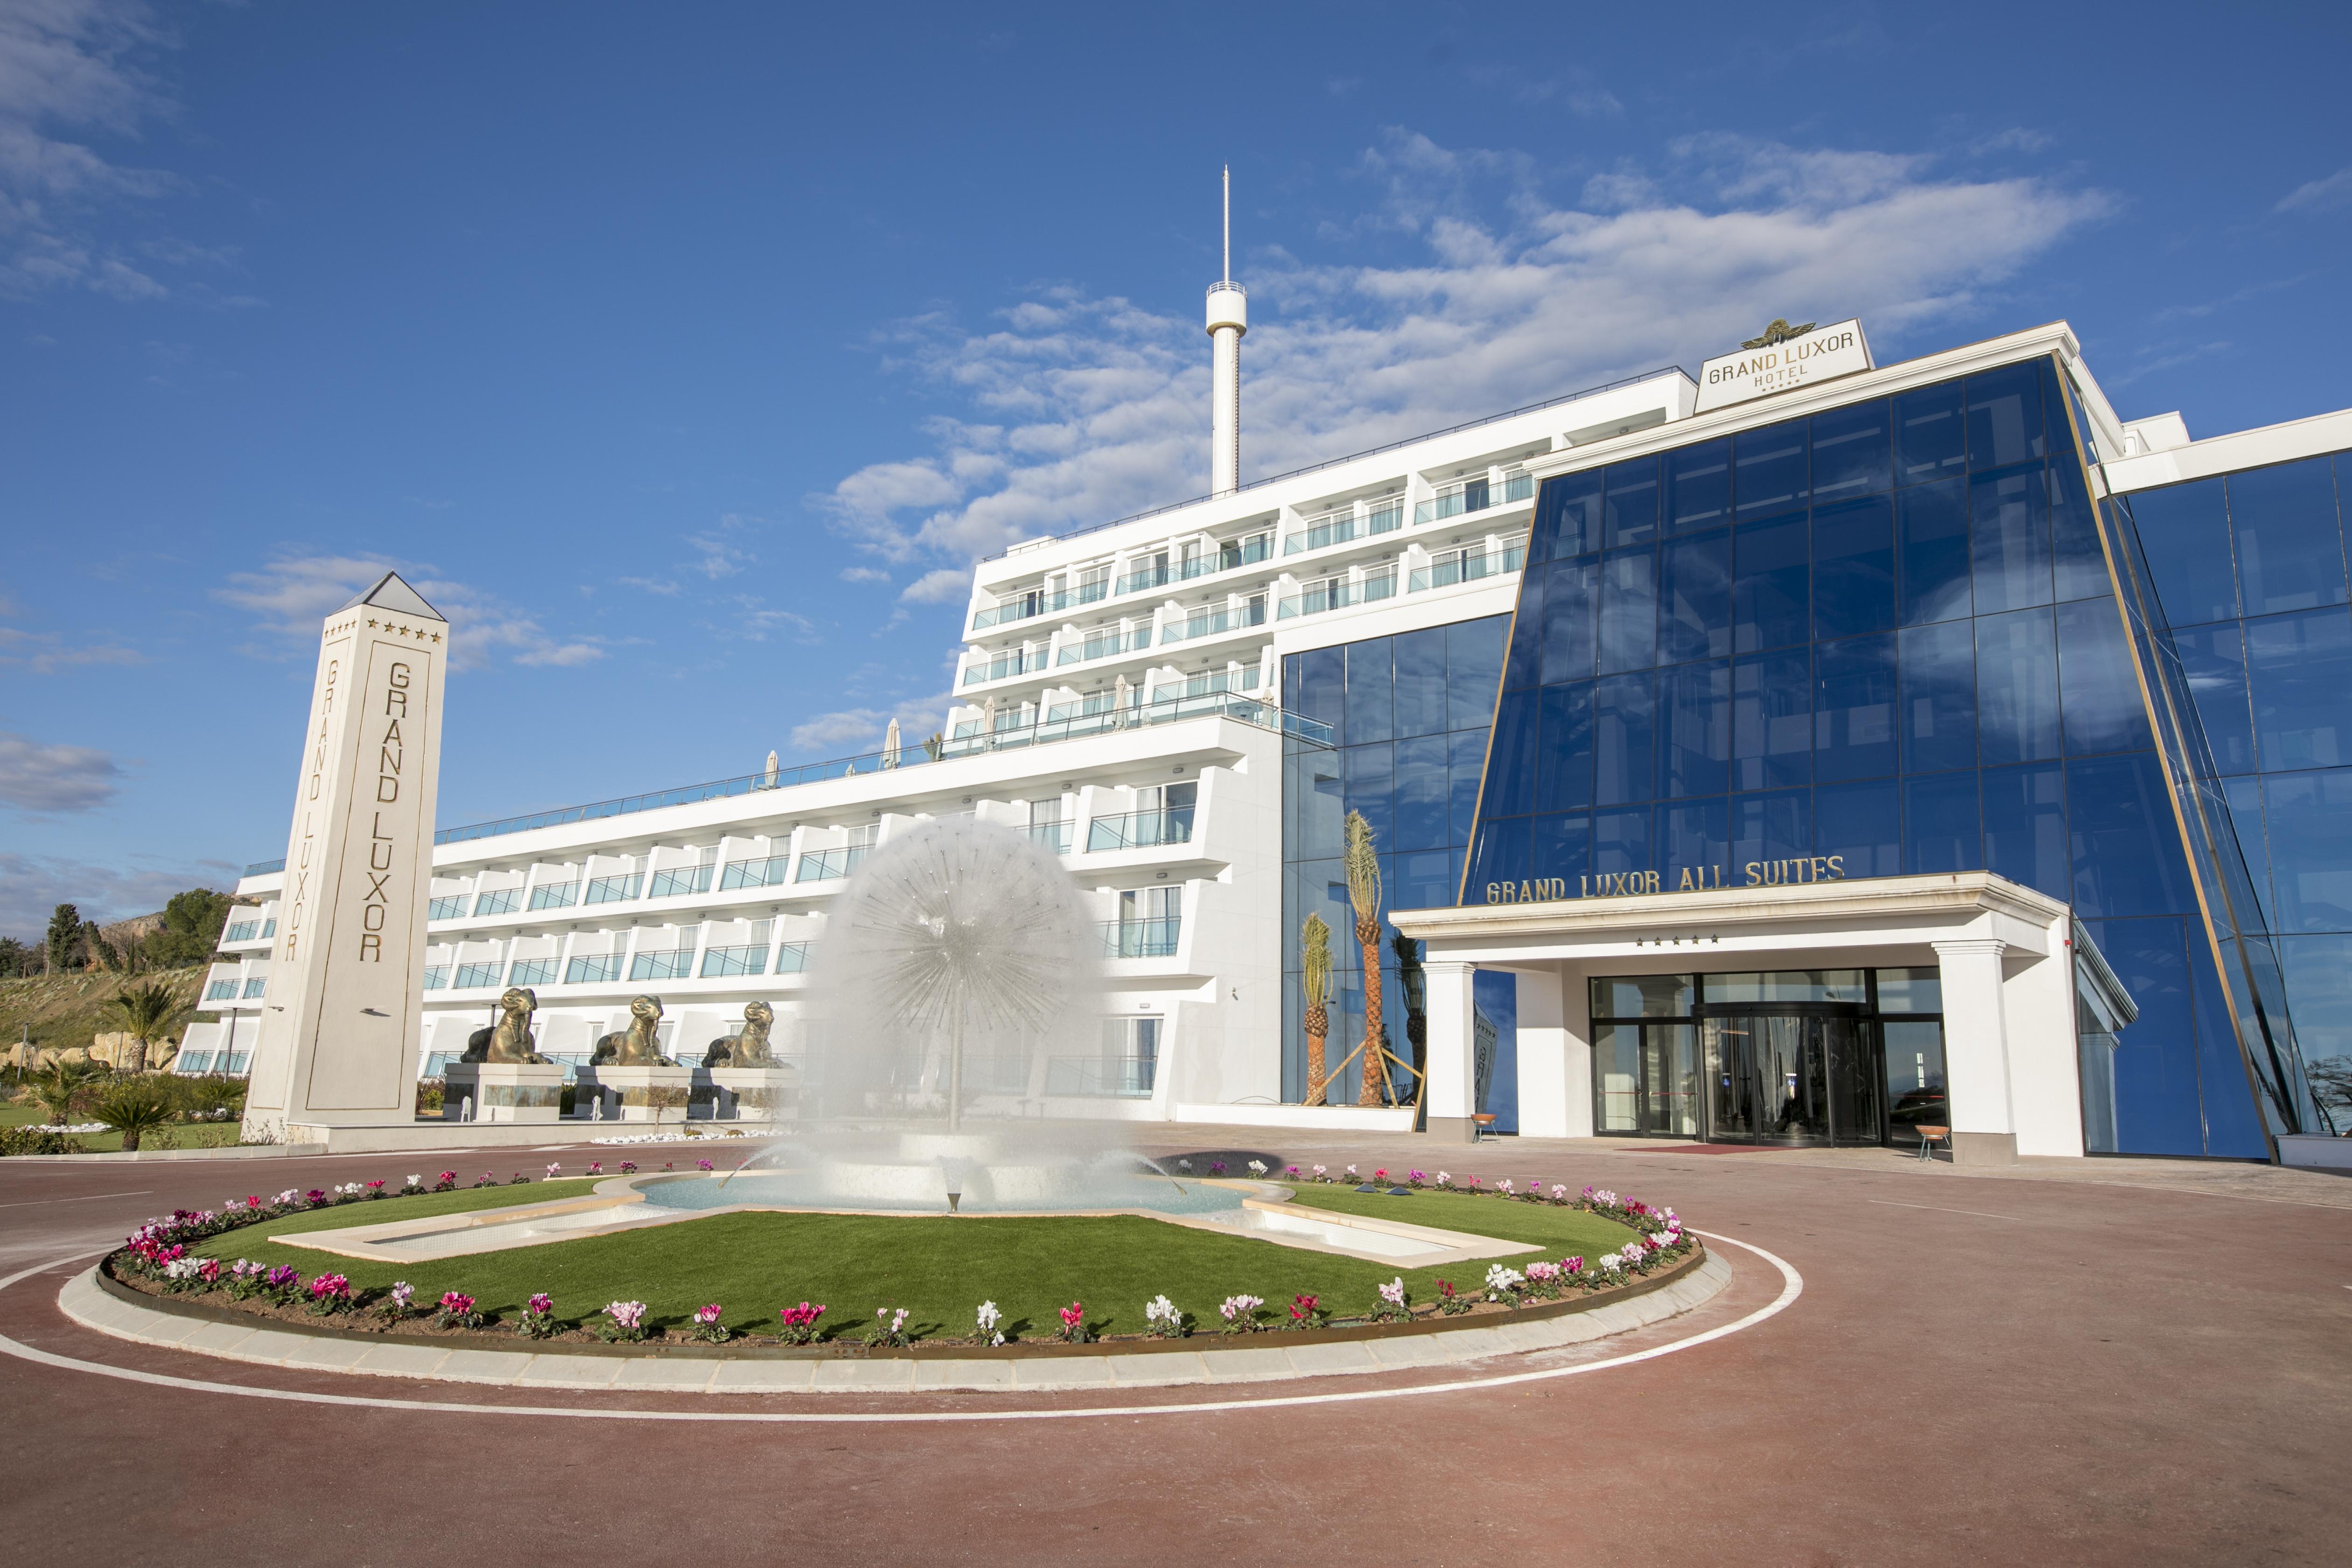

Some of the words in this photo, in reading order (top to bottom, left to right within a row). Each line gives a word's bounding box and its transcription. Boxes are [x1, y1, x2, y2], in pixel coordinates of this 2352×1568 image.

[1709, 354, 1777, 384] GRAND
[1785, 332, 1854, 364] LUXOR
[1755, 365, 1807, 386] HOTEL
[310, 660, 338, 801] GRAND
[378, 663, 410, 803] GRAND
[286, 812, 313, 961] LUXOR
[360, 812, 393, 962] LUXOR
[1487, 878, 1565, 903] GRAND
[1580, 870, 1660, 898] LUXOR
[1680, 865, 1730, 891] ALL
[1746, 855, 1844, 887] SUITES
